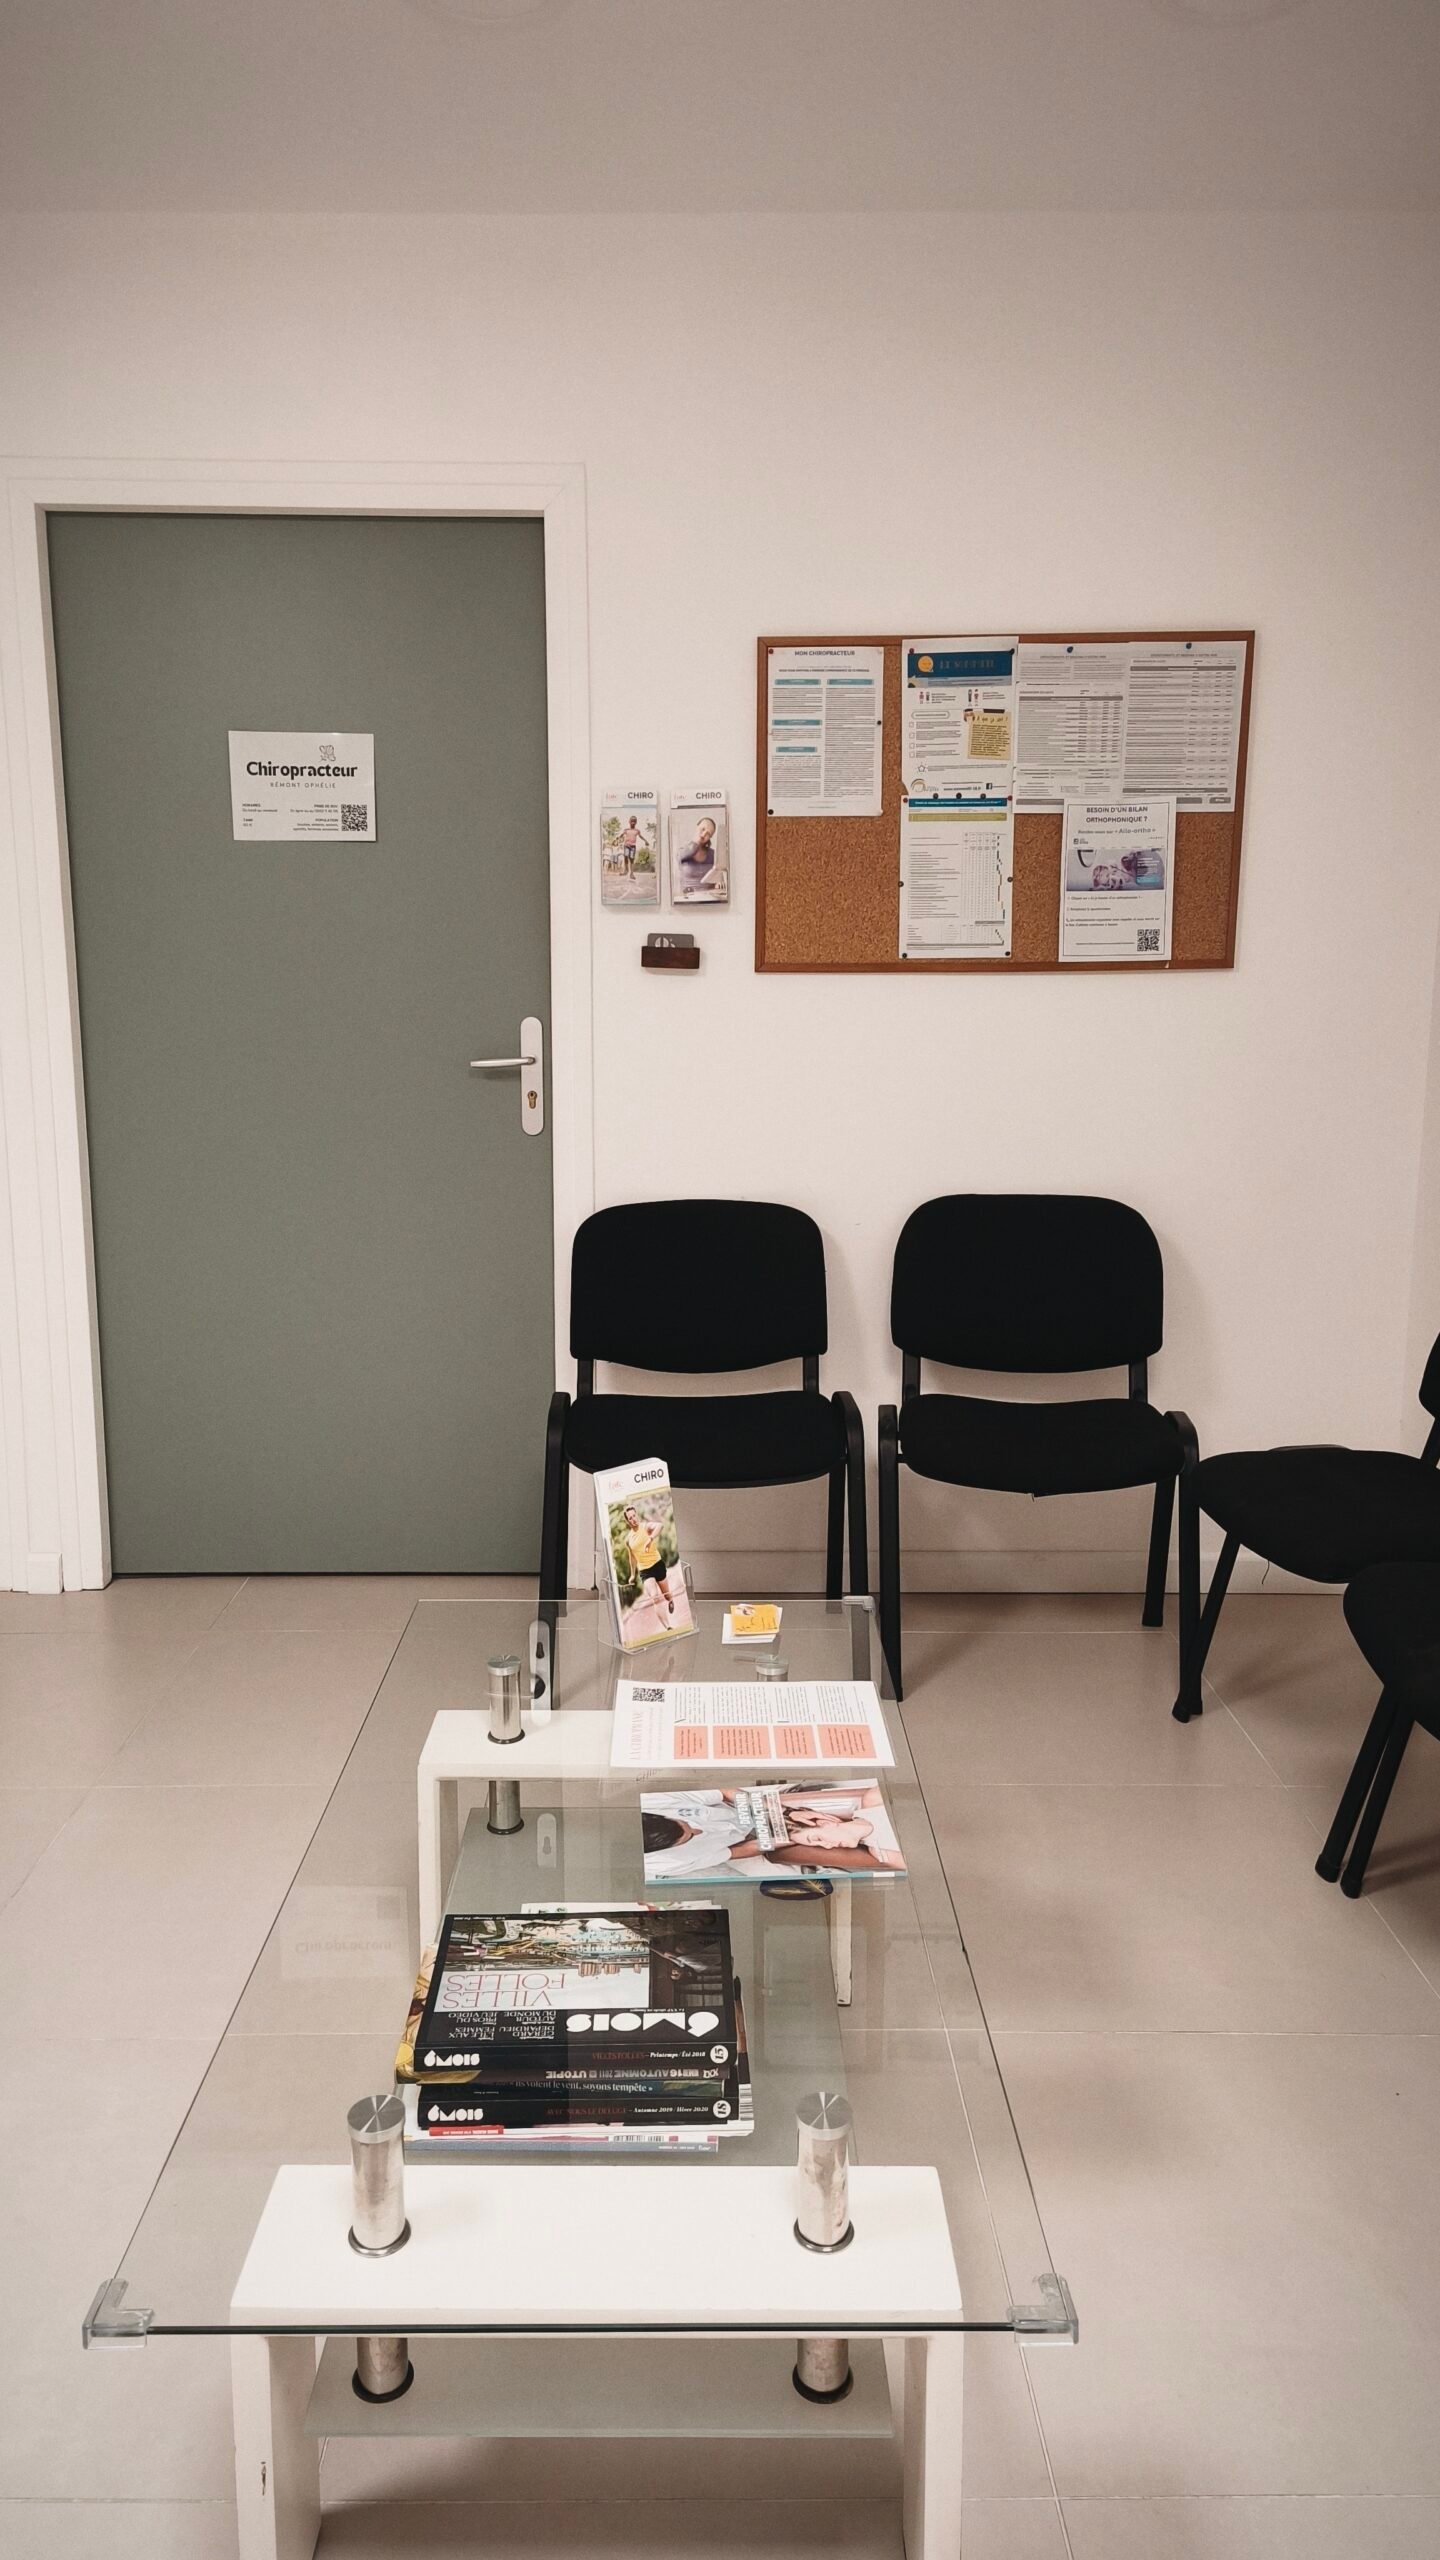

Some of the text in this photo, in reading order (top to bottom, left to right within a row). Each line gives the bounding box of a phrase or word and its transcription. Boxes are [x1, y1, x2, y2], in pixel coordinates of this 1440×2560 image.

[246, 761, 358, 780] Chiropracteur
[627, 791, 654, 799] CHIRO
[695, 791, 722, 800] CHIRO
[634, 1468, 664, 1483] CHIRO
[736, 1792, 750, 1825] DEVENIR
[751, 1792, 772, 1850] CHIROPRACTEUR
[447, 1973, 565, 1991] FOLLES
[443, 1990, 552, 2008] VILLES
[715, 2047, 724, 2060] 15
[546, 2070, 587, 2079] UTOPIE
[599, 2069, 613, 2078] 2011
[613, 2069, 669, 2078] AUTOMNE
[553, 2080, 560, 2089] le
[561, 2081, 582, 2090] vent,
[582, 2083, 612, 2092] soyons
[612, 2083, 647, 2094] tempête
